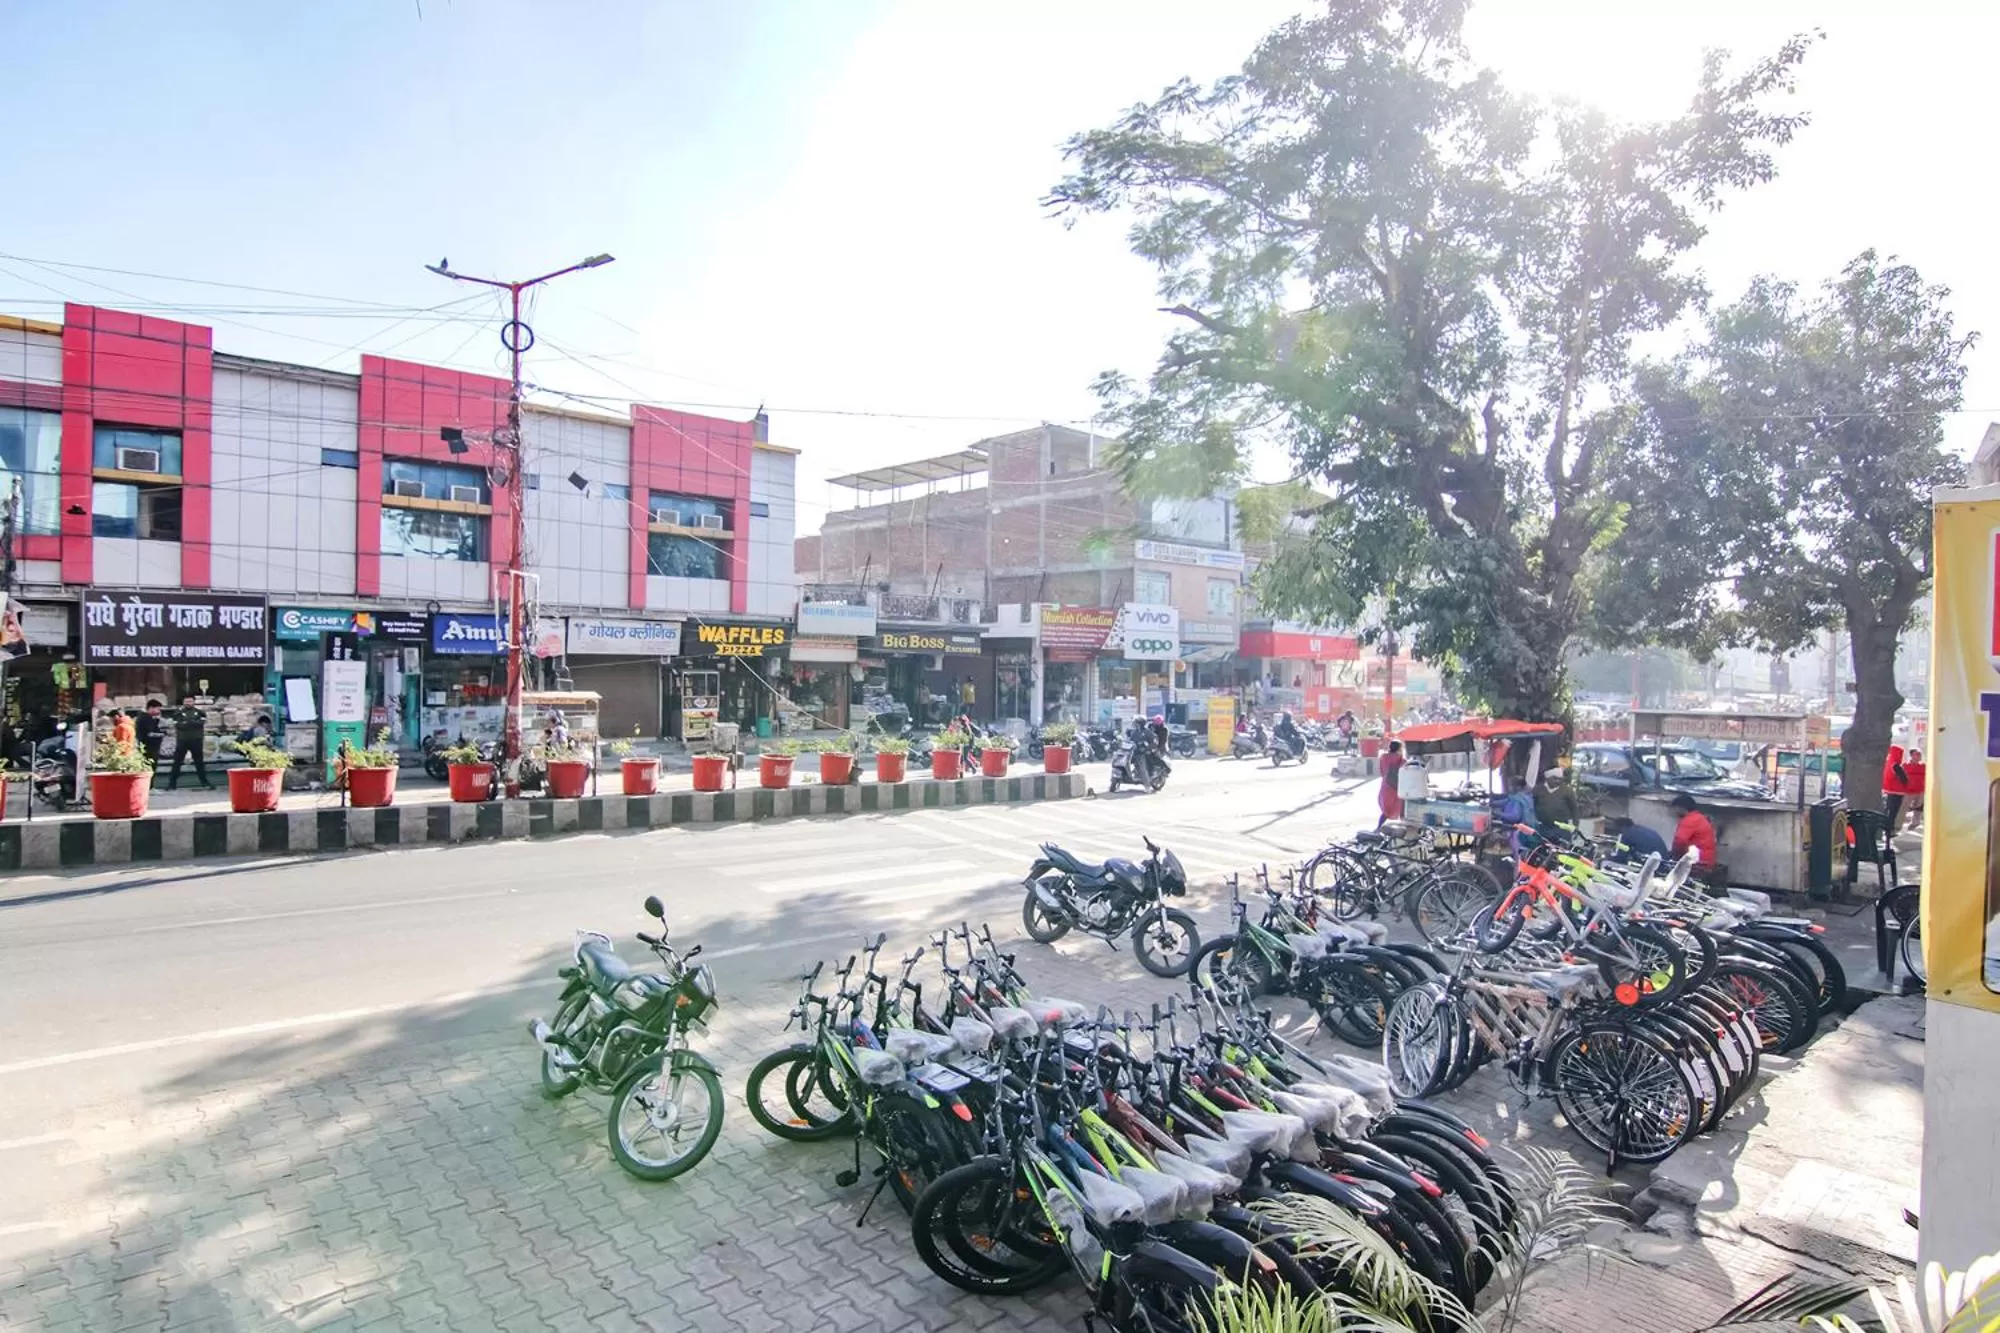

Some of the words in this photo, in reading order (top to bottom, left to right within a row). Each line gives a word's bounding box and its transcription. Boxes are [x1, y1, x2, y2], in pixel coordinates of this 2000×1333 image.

[86, 595, 117, 627] राधे
[121, 596, 164, 636] मुरैना
[168, 604, 214, 629] गजक
[300, 615, 347, 625] CASHIFY
[1136, 608, 1171, 625] vivo
[588, 621, 626, 640] गोयल
[698, 625, 785, 645] WAFFLES
[90, 645, 111, 657] THE
[113, 645, 138, 657] REAL
[140, 645, 169, 658] TASTE
[170, 646, 184, 658] OF
[722, 646, 756, 655] PIZZA
[1132, 639, 1173, 654] oppo
